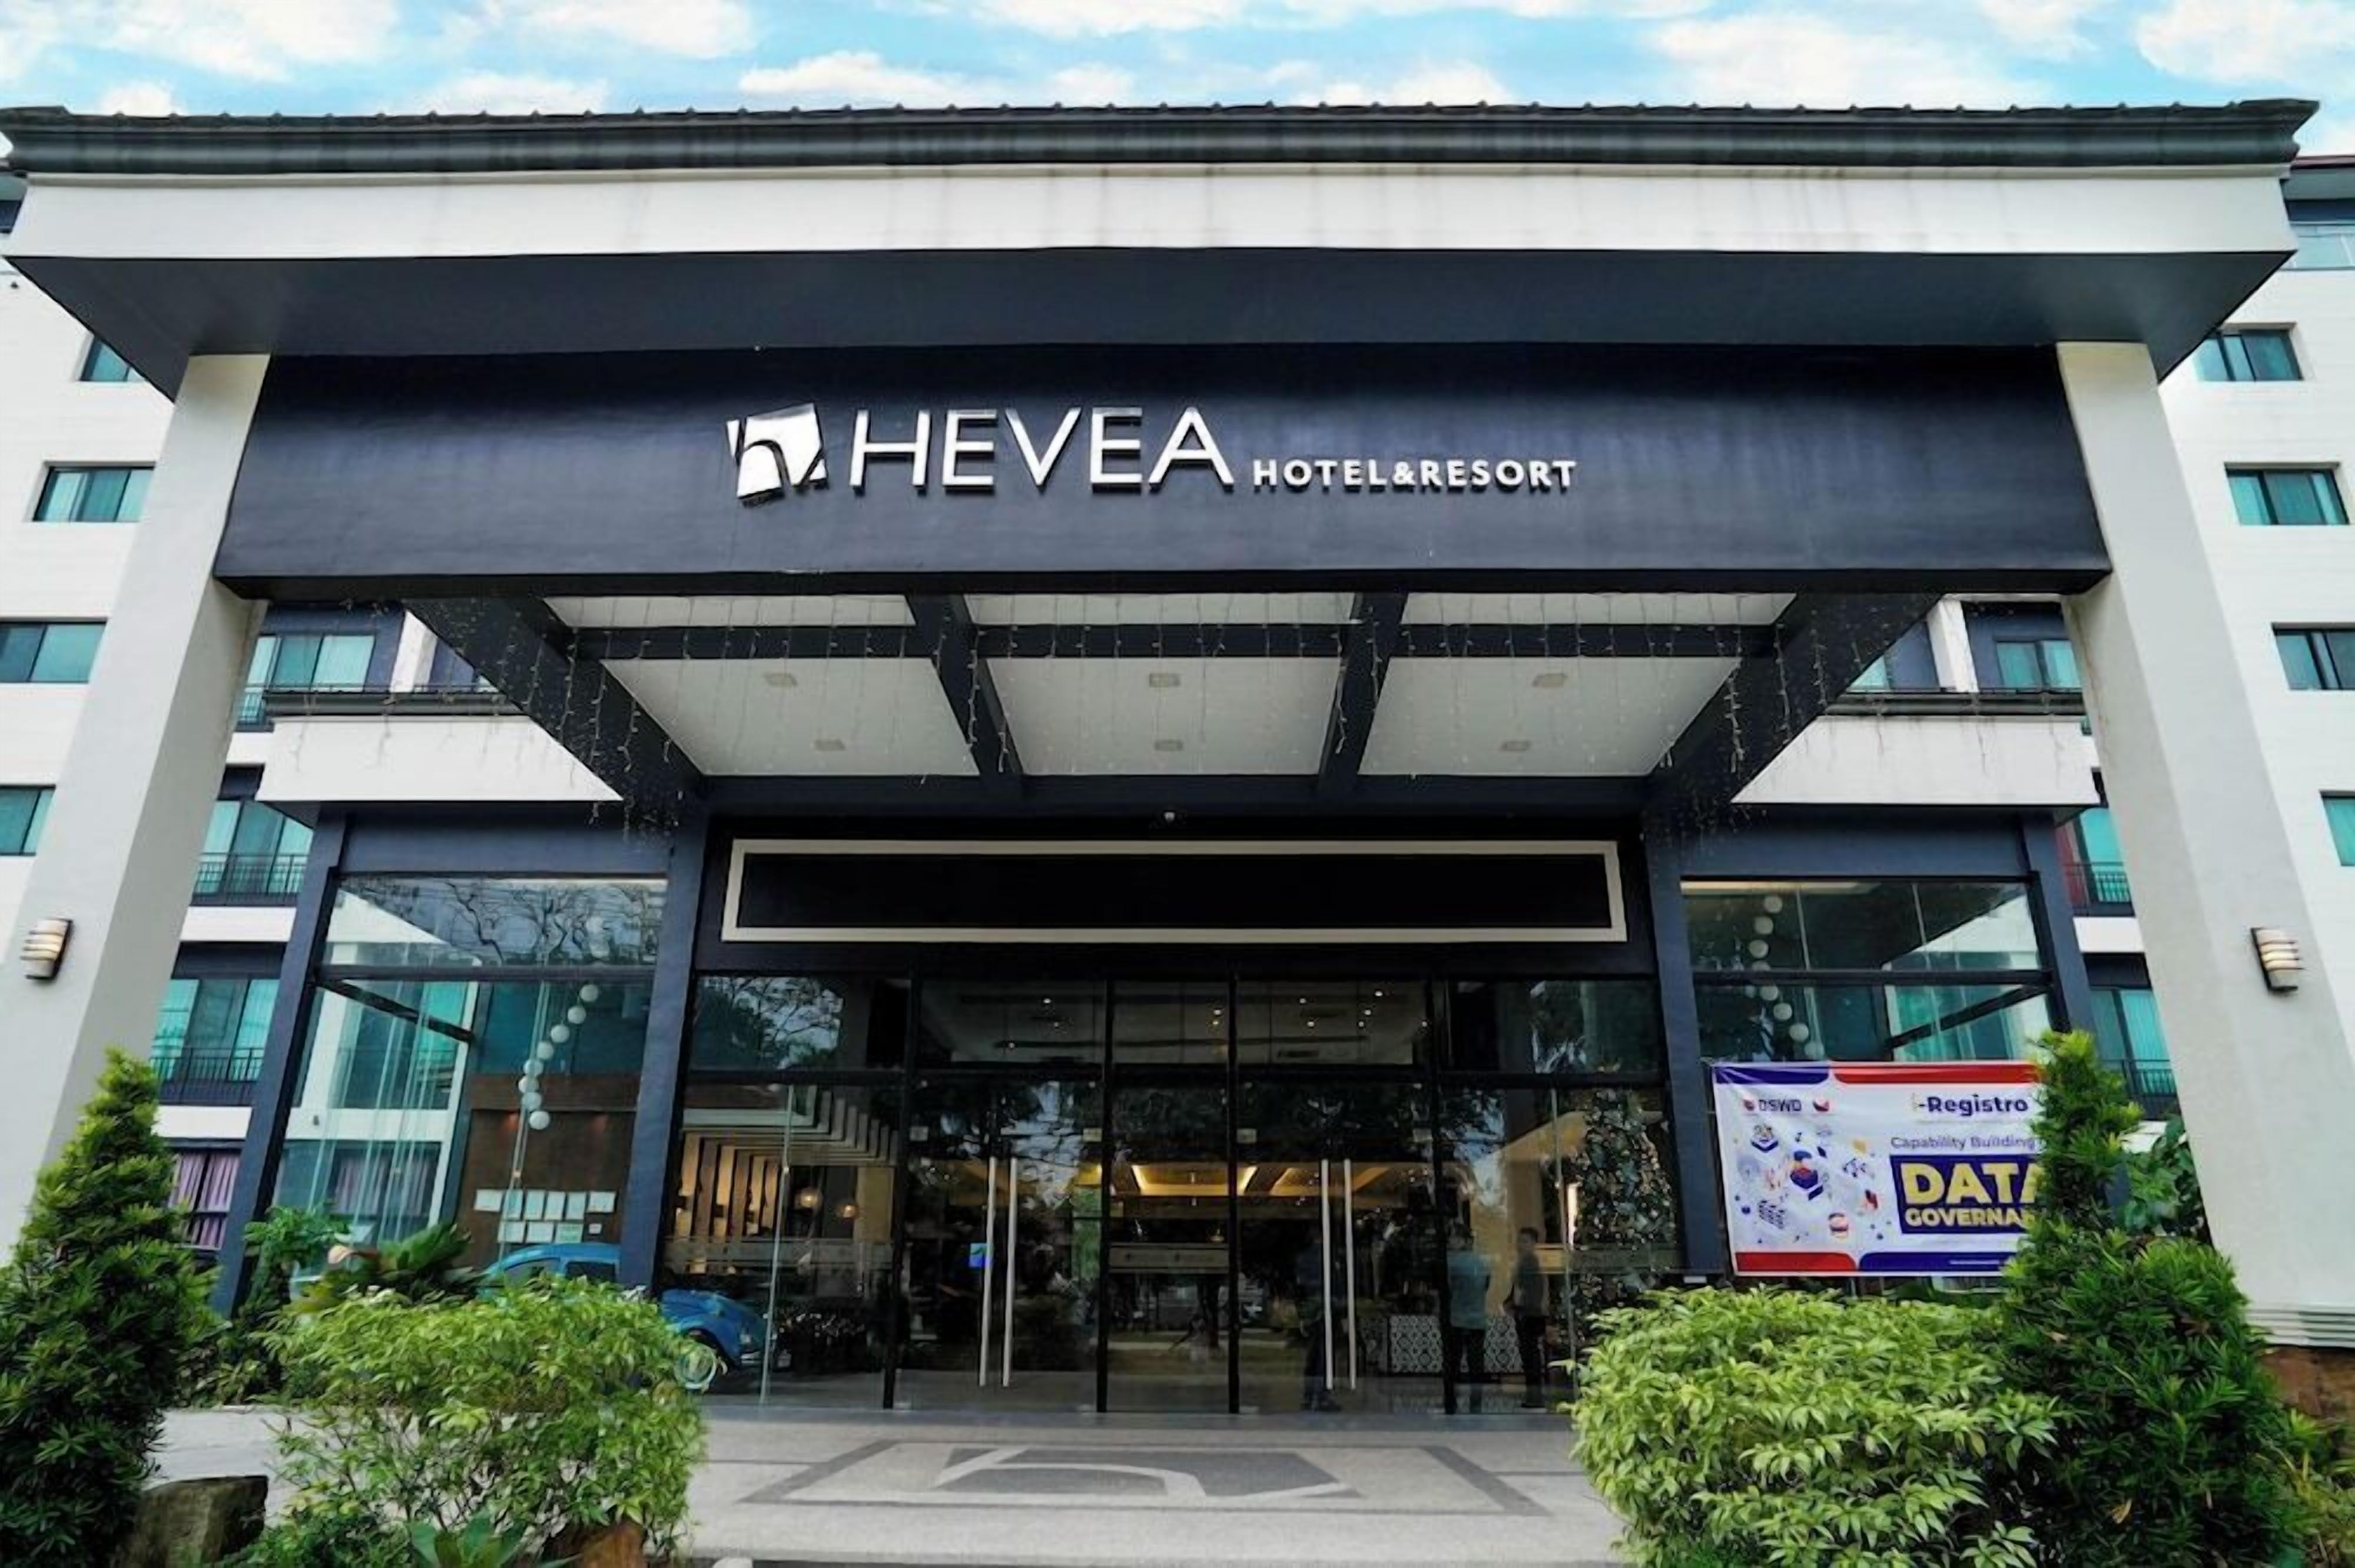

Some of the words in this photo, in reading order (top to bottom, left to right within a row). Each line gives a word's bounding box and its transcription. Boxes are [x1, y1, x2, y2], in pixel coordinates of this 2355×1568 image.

[850, 407, 1235, 487] HEVEA
[1252, 459, 1577, 488] HOTEL&RESORT
[1905, 1207, 2035, 1227] GOVERNA
